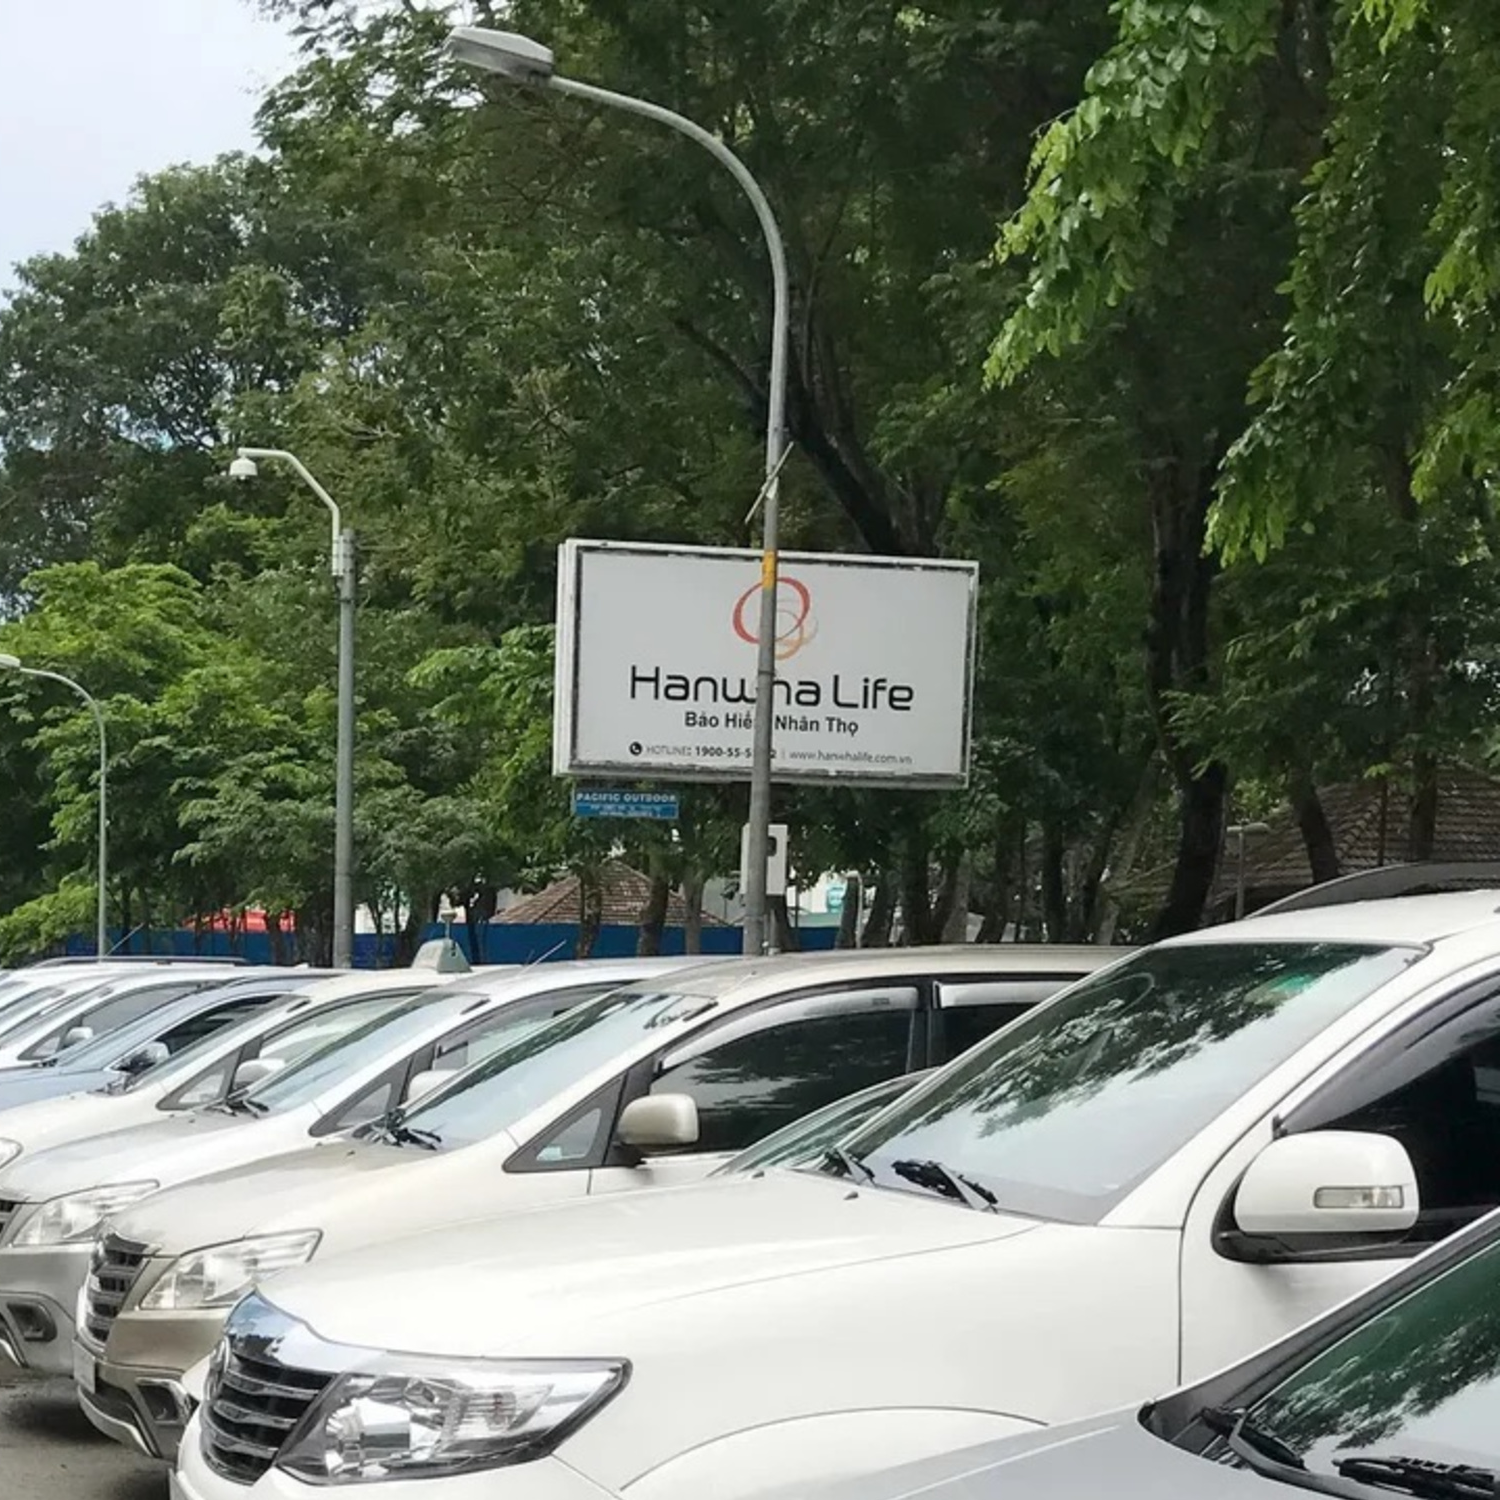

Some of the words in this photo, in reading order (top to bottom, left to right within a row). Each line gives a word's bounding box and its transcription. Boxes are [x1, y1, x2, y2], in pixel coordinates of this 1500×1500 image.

[630, 664, 821, 706] Hanwha
[832, 673, 914, 711] Life
[774, 714, 820, 732] Nhân
[825, 716, 859, 737] Thọ
[646, 745, 692, 756] HOTLINE:
[790, 750, 913, 764] www.hanwhalife.com.vn
[576, 793, 621, 801] PACIFIC
[623, 793, 676, 803] OUTDOOR
